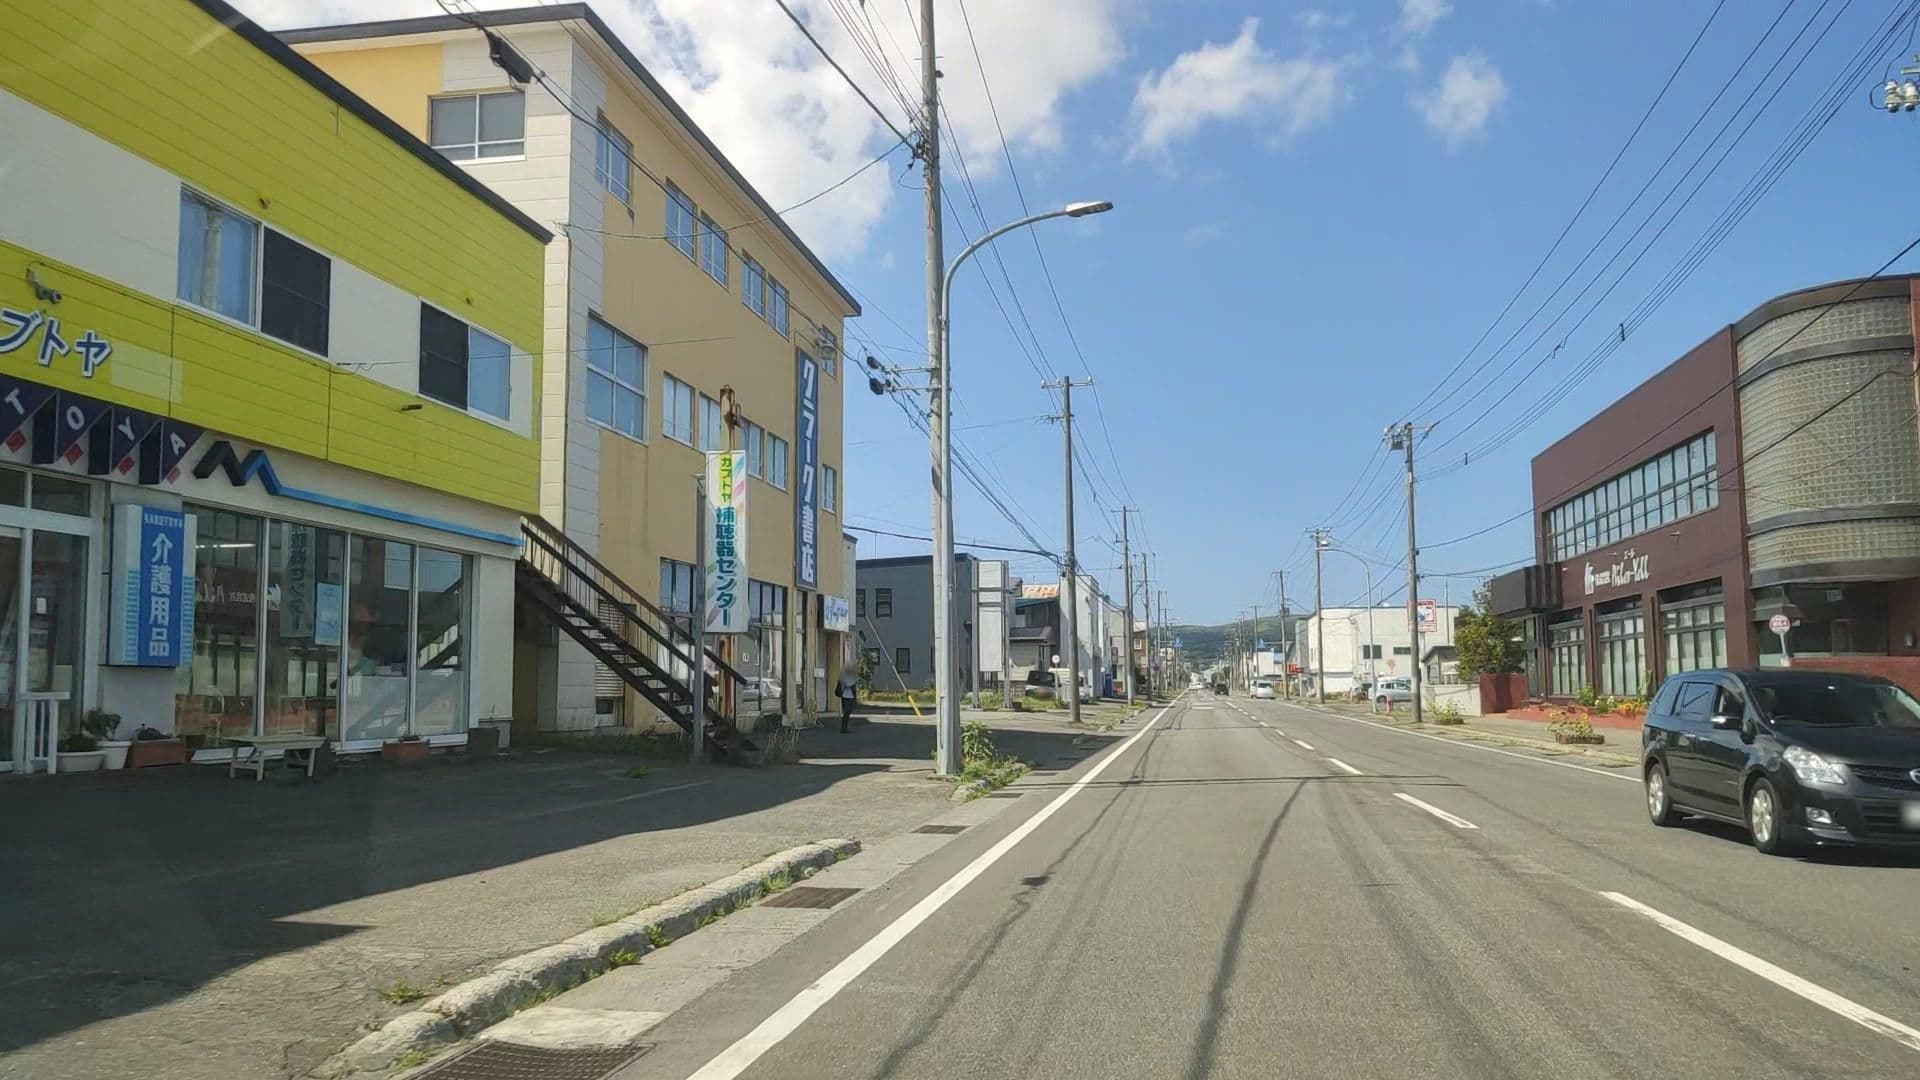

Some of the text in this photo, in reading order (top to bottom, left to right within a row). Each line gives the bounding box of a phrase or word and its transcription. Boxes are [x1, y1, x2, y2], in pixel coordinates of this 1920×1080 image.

[0, 309, 111, 377] ブトヤ
[801, 359, 815, 584] クラーク書店
[149, 532, 173, 657] 介護用品
[715, 505, 736, 626] 補聴器センター
